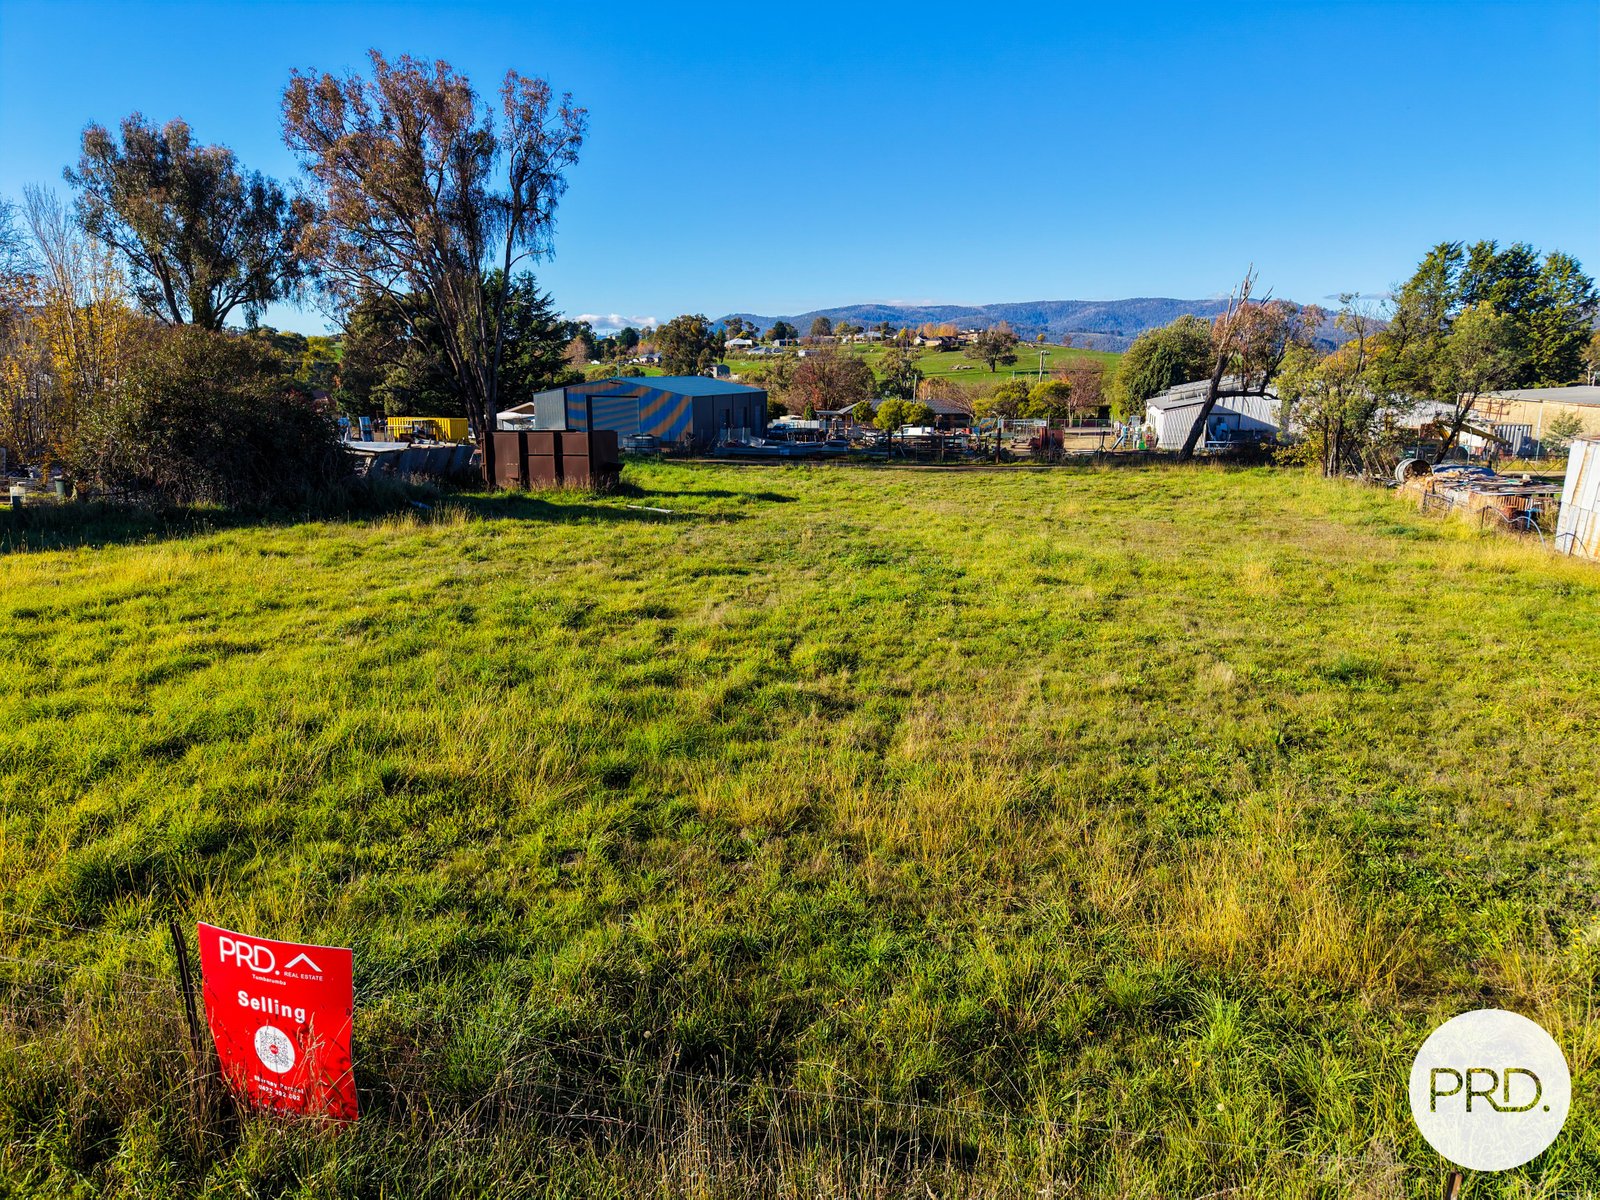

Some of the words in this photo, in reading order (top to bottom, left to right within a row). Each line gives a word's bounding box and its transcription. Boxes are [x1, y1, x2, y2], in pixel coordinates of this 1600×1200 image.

[219, 936, 281, 976] PRD.
[283, 971, 299, 979] REAL
[300, 973, 324, 982] ESTATE
[237, 990, 306, 1024] Selling
